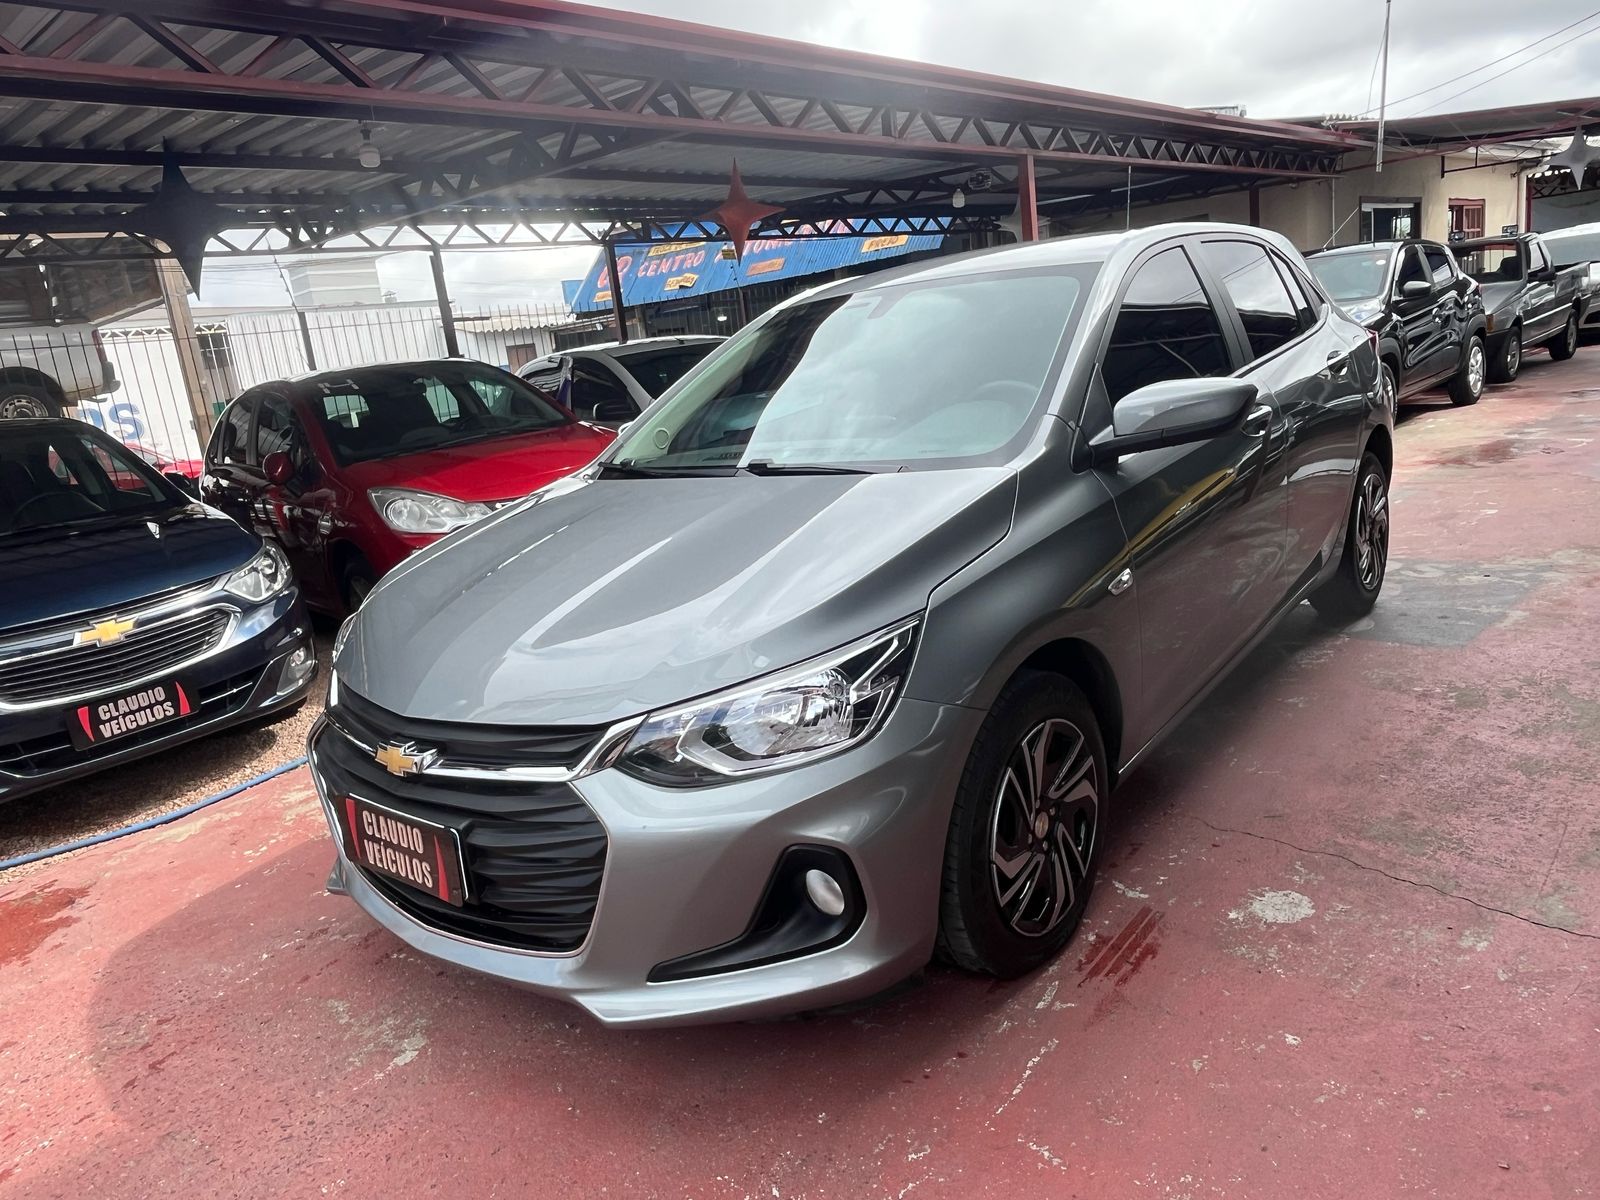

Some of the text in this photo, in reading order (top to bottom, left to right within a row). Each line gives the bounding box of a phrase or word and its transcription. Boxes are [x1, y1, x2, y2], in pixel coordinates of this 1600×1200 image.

[638, 250, 705, 277] CENTRO
[98, 686, 166, 721] CLAUDIO
[99, 701, 175, 738] VEÍCULOS
[362, 810, 424, 854] CLAUDIO
[364, 840, 433, 888] VEÍCULOS
